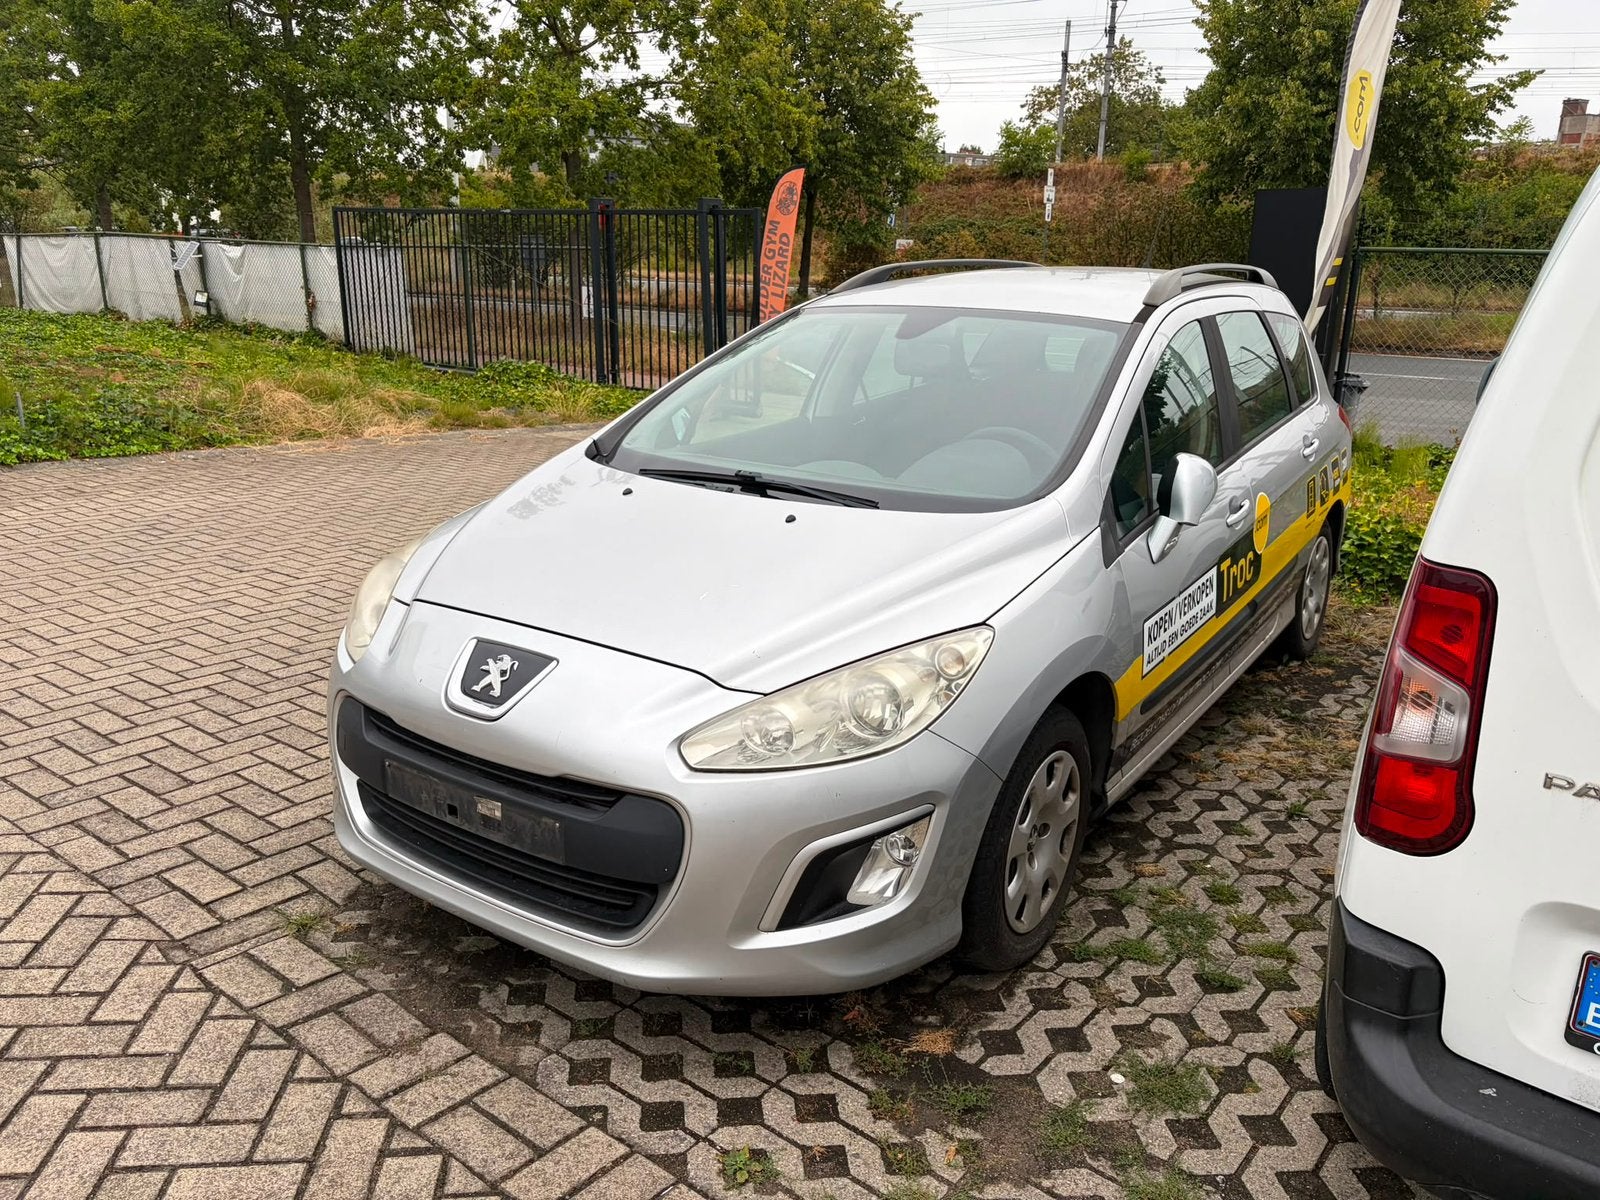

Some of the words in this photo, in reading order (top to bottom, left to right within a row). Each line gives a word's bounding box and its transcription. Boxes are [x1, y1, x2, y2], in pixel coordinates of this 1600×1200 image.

[764, 220, 780, 260] GYM
[771, 232, 791, 299] LIZARD
[760, 263, 773, 322] ULDER
[1220, 550, 1254, 602] Troc
[1146, 639, 1167, 667] ALTIJD
[1168, 628, 1179, 647] EEN
[1180, 611, 1199, 637] GOEDE
[1199, 598, 1214, 621] ZAAK
